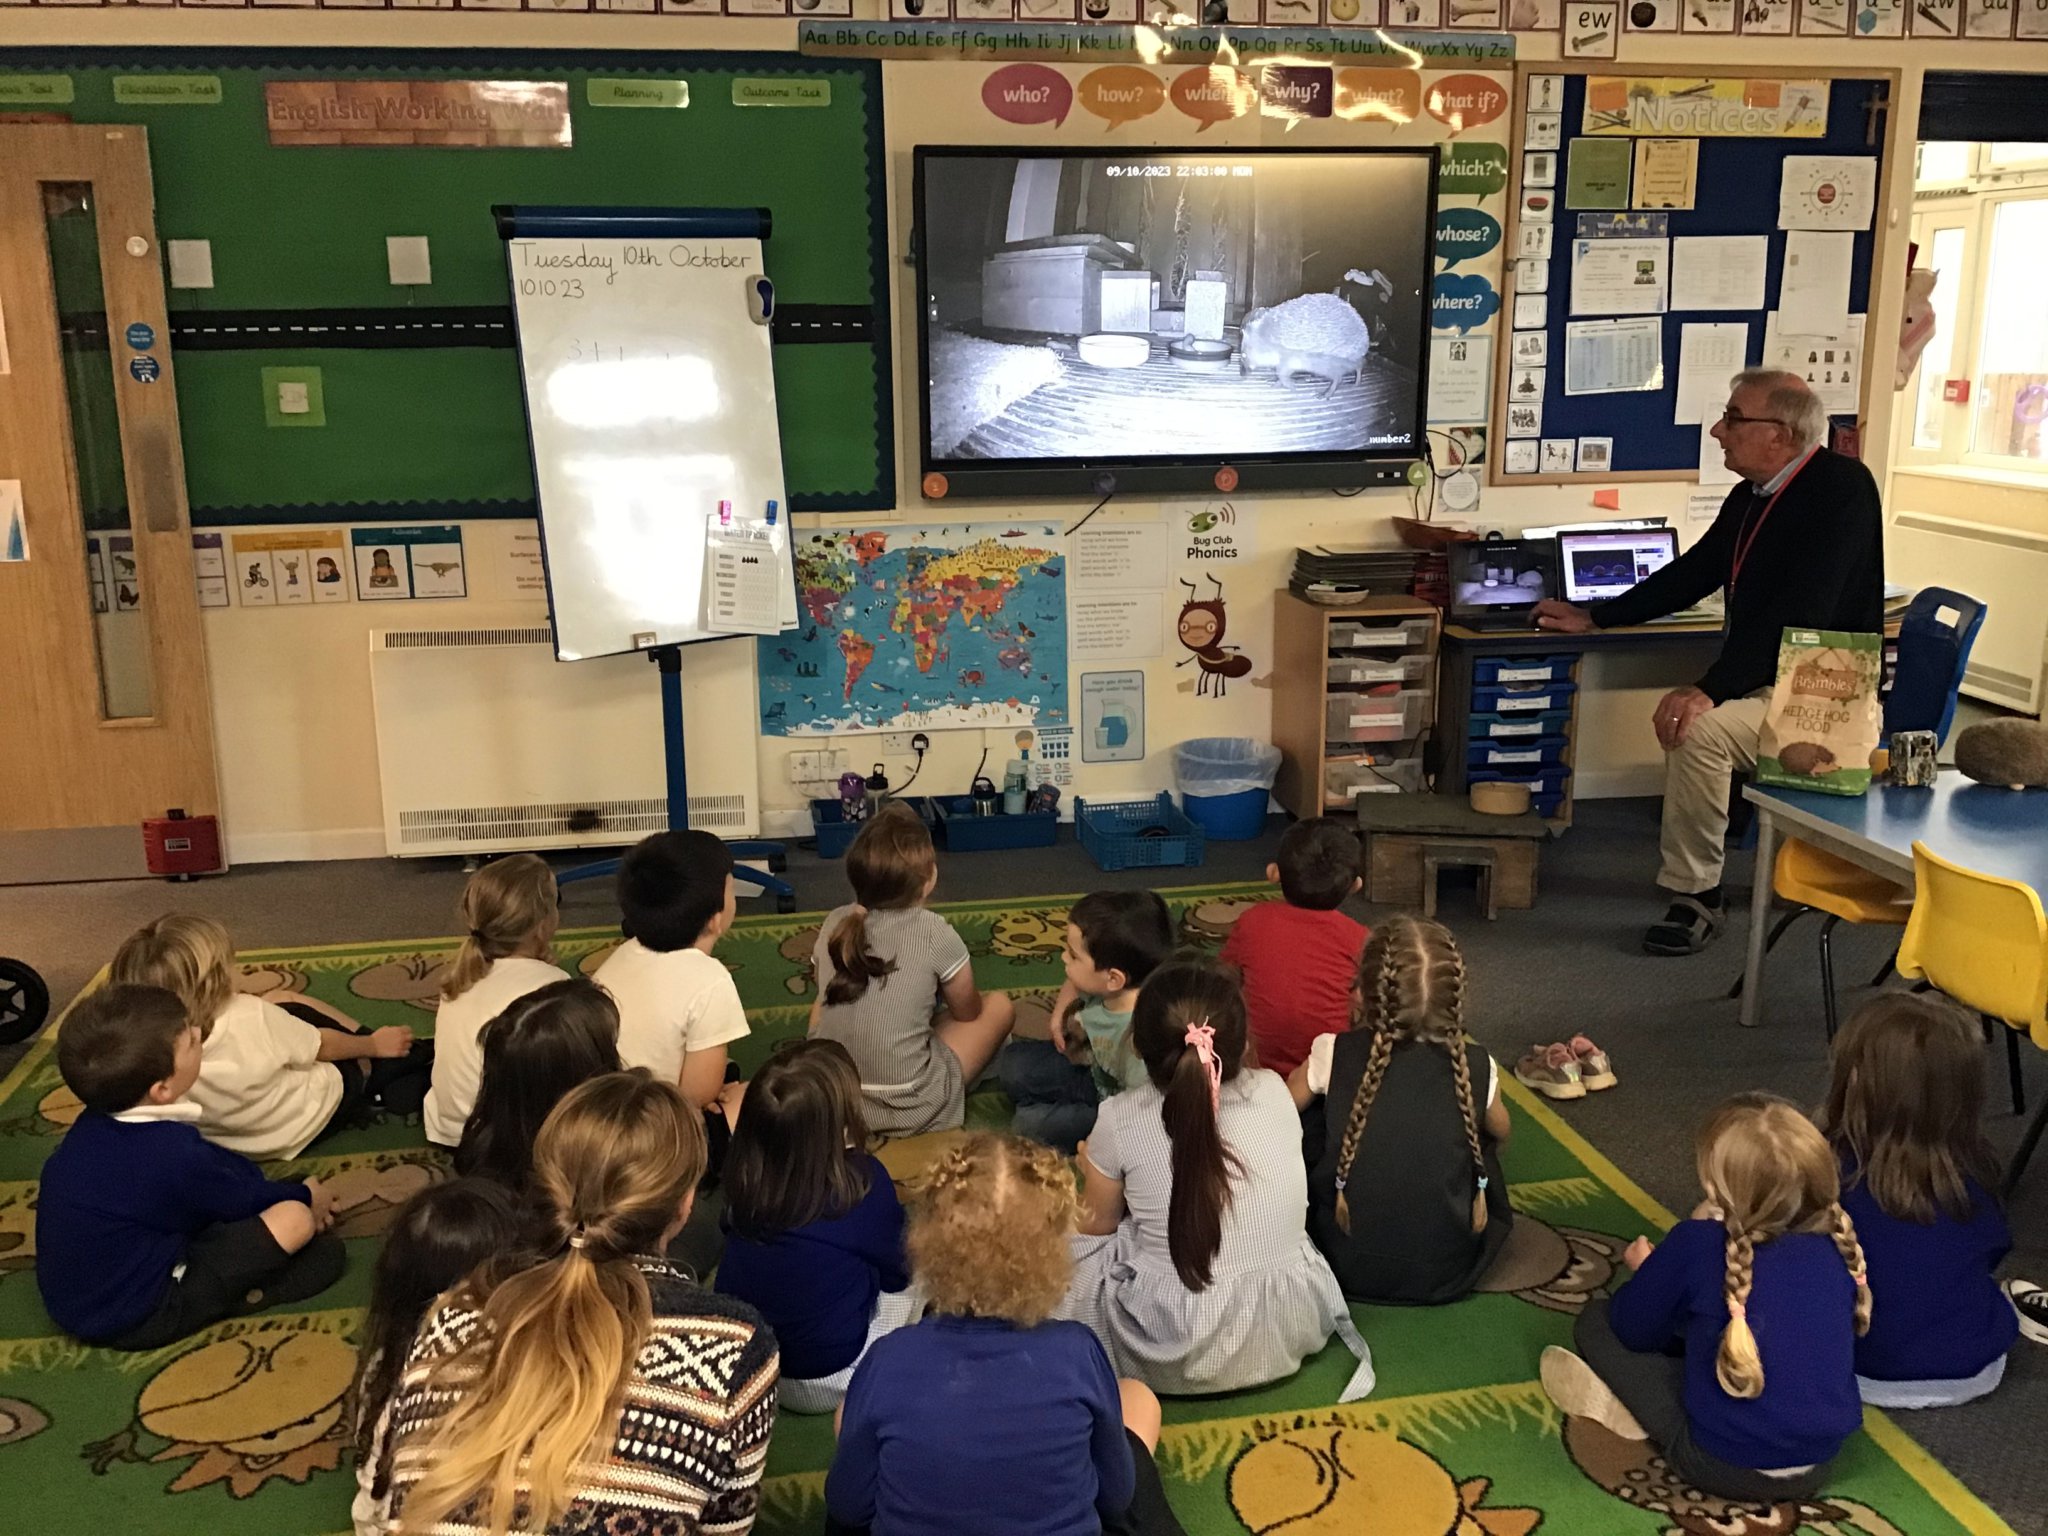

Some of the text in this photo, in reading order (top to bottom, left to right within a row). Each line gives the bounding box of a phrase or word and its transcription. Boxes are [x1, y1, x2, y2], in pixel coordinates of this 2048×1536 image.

[1578, 11, 1612, 28] ew
[805, 29, 830, 45] Aa
[836, 29, 861, 45] Bb
[866, 30, 889, 46] Cc
[894, 30, 919, 46] Dd
[926, 31, 946, 46] Ee
[951, 30, 967, 53] Ff
[974, 32, 997, 53] Gg
[1005, 32, 1031, 48] Hh
[1037, 33, 1052, 49] Ii
[1057, 33, 1071, 54] Jj
[1080, 34, 1101, 50] Kk
[1170, 36, 1194, 51] Nn
[1306, 37, 1324, 52] Ss
[1329, 37, 1347, 53] Tt
[1351, 39, 1374, 53] Uu
[1440, 41, 1460, 57] Xx
[1465, 42, 1483, 62] Yy
[1489, 42, 1508, 57] Zz
[613, 86, 664, 102] Planning
[742, 86, 822, 98] Outcome Task
[1003, 85, 1051, 104] who?
[1097, 84, 1144, 103] how?
[1274, 81, 1321, 103] why?
[1478, 91, 1499, 113] if?
[270, 96, 368, 128] English
[375, 96, 491, 128] Working
[1633, 95, 1780, 134] Notices
[1106, 166, 1171, 177] 09/10/2023
[1176, 166, 1227, 177] 22:03:00
[1439, 157, 1493, 176] which?
[511, 242, 752, 285] Tuesday 10th October
[1369, 433, 1411, 444] number2
[1193, 535, 1233, 547] Bug Club
[1187, 546, 1238, 560] Phonics
[1782, 705, 1850, 723] HEDGEHOG
[1796, 718, 1831, 734] FOOD
